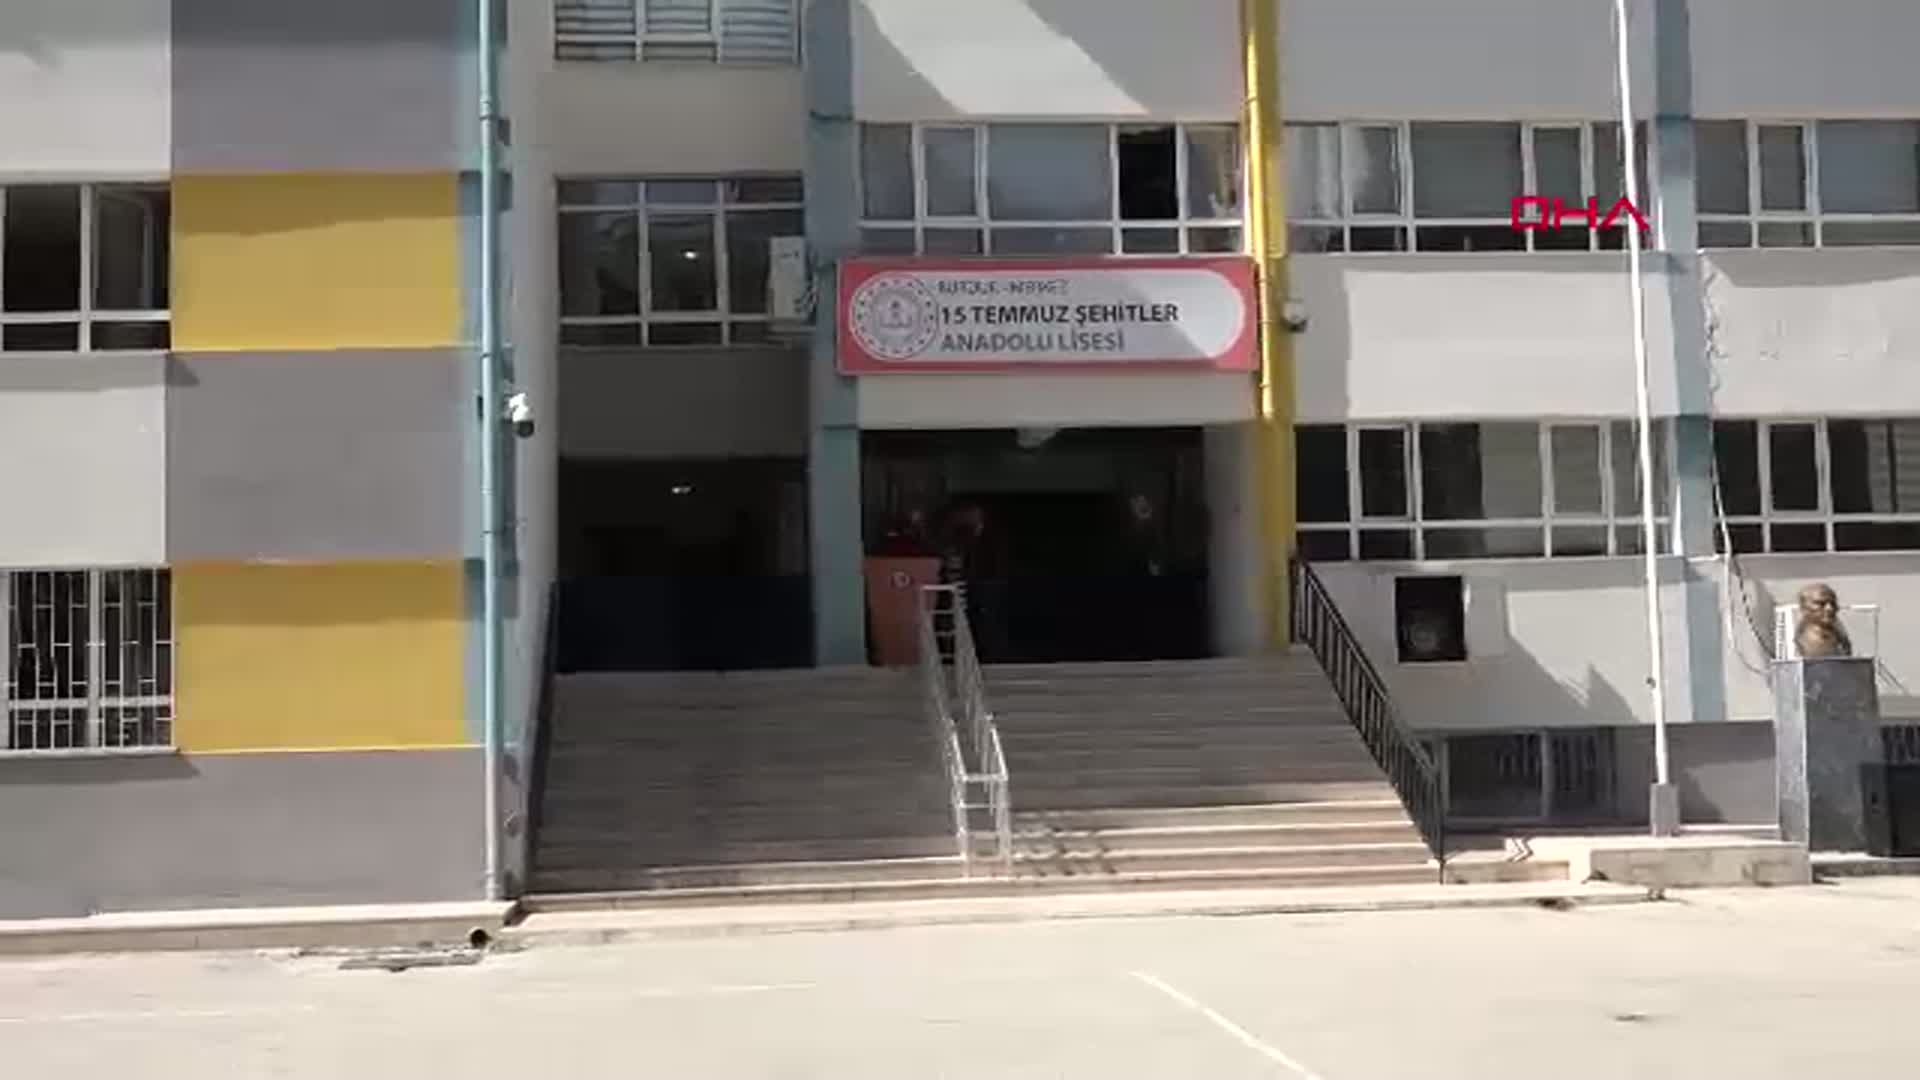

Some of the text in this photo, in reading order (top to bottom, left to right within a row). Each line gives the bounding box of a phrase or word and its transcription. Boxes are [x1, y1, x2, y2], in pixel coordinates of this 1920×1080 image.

[942, 301, 1179, 326] 15 TEMMUZ ŞEHİTLER
[941, 326, 1124, 351] ANADOLU LİSESİ
